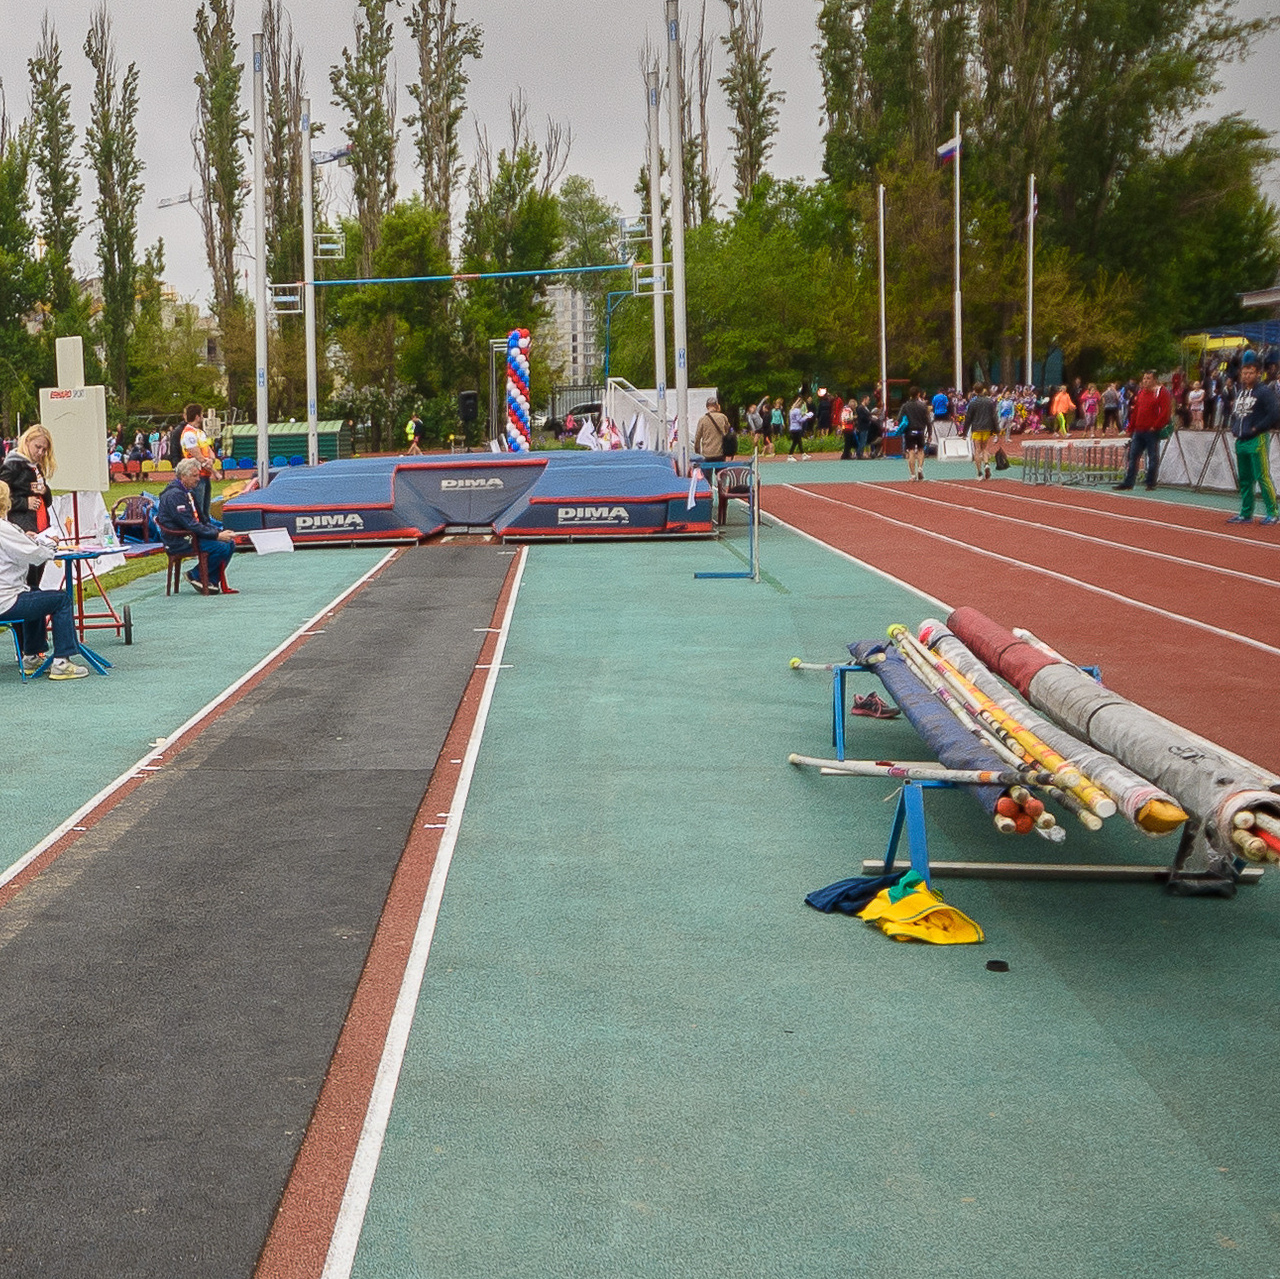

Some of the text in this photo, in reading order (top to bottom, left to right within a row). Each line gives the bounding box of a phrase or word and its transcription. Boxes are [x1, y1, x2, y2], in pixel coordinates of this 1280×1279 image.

[441, 478, 504, 487] DIMA
[558, 507, 630, 518] DIMA
[296, 513, 364, 527] DIMA
